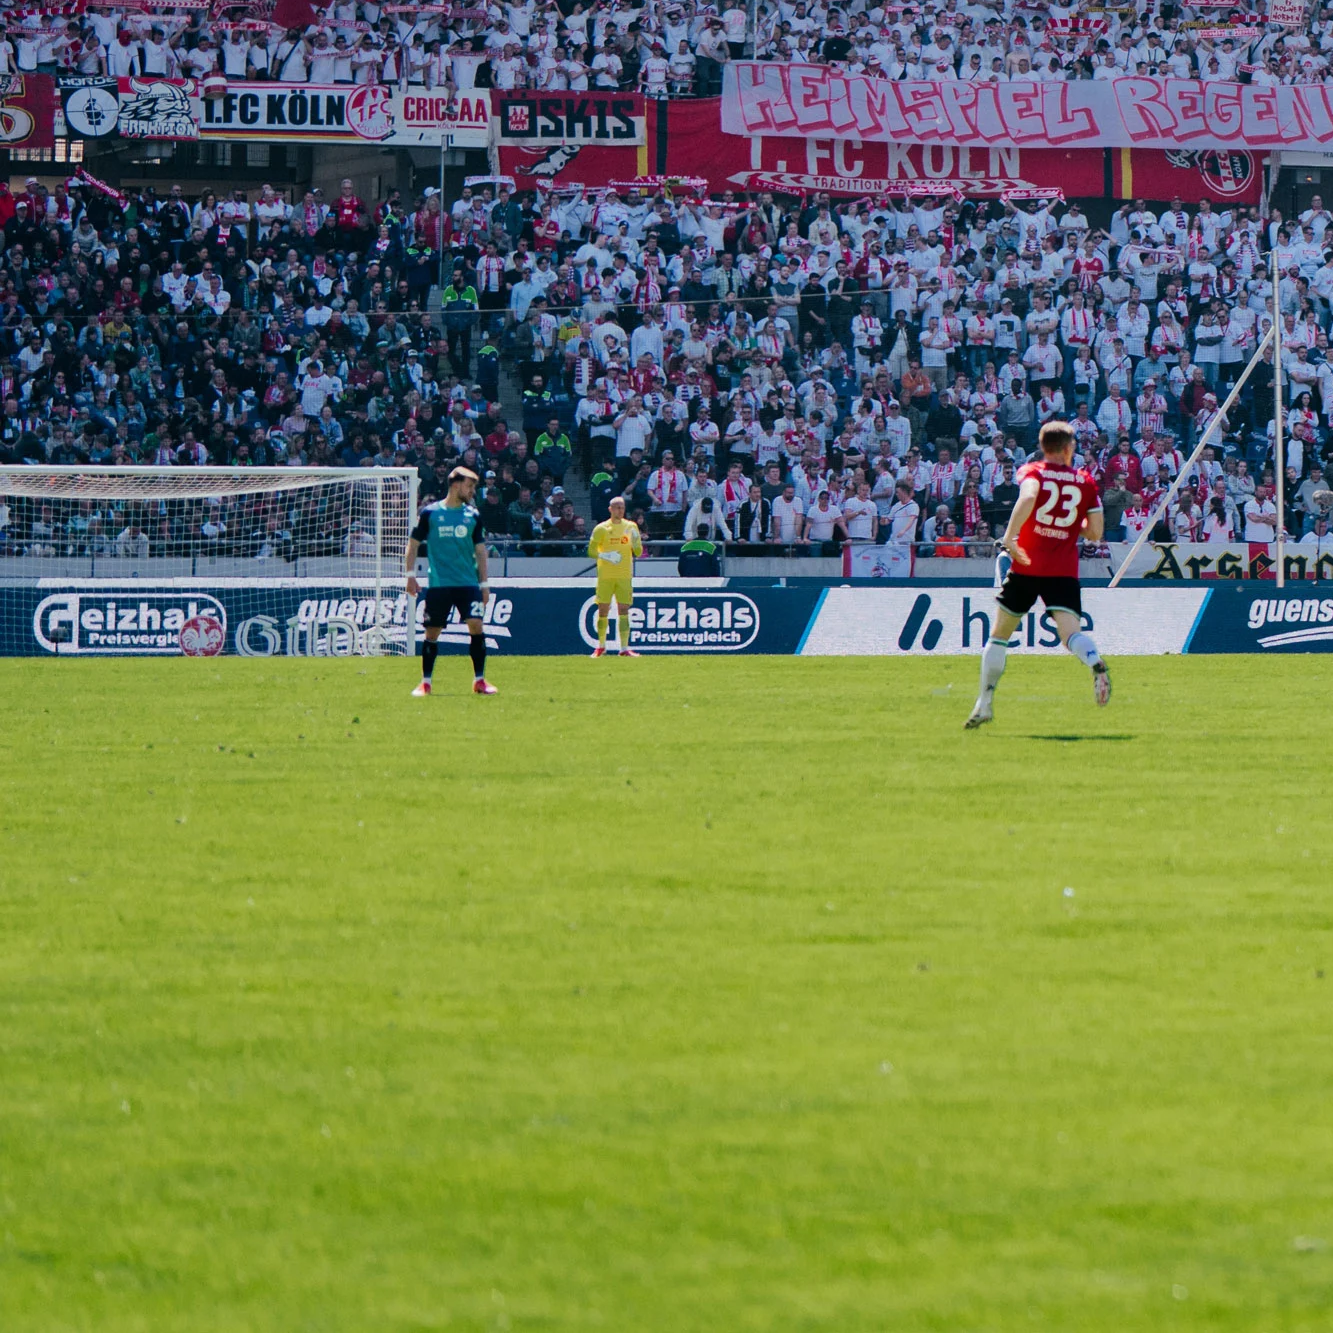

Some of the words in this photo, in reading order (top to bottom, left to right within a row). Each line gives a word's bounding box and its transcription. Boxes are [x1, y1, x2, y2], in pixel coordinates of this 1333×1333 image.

[202, 93, 259, 124] 1.FC
[266, 89, 345, 127] KÖLN
[120, 118, 198, 137] FRAKTION
[806, 138, 865, 178] FC
[814, 176, 883, 191] TRADITION
[1035, 480, 1082, 528] 23
[89, 632, 181, 646] Preisvergle
[630, 629, 742, 646] Preisvergleich
